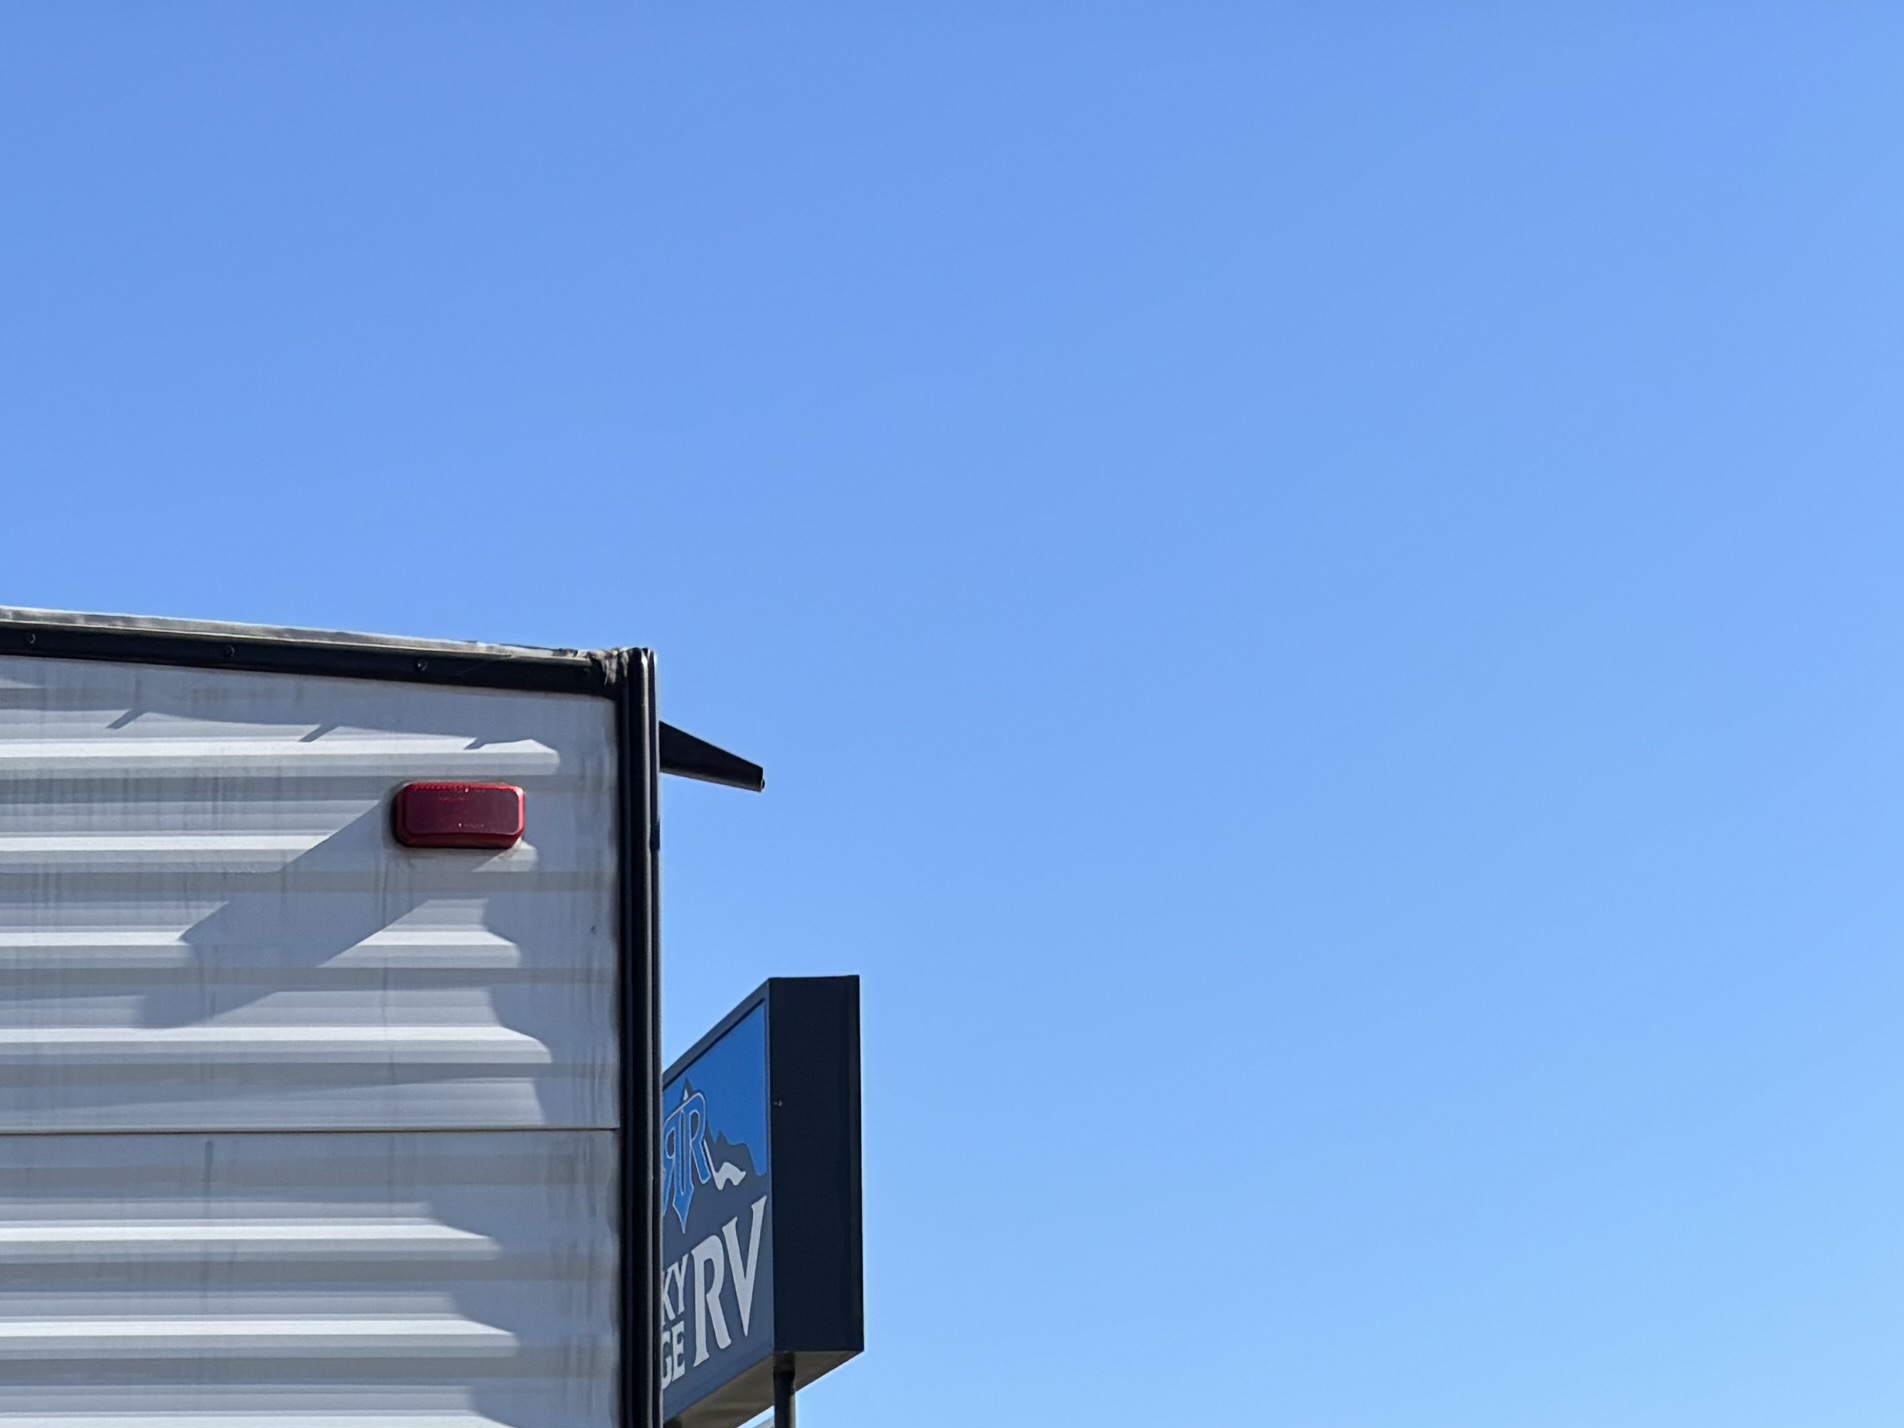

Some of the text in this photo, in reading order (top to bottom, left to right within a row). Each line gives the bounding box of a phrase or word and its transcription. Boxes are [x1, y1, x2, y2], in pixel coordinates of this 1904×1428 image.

[663, 1253, 688, 1320] KY
[691, 1195, 767, 1368] RV
[662, 1320, 685, 1390] GE
